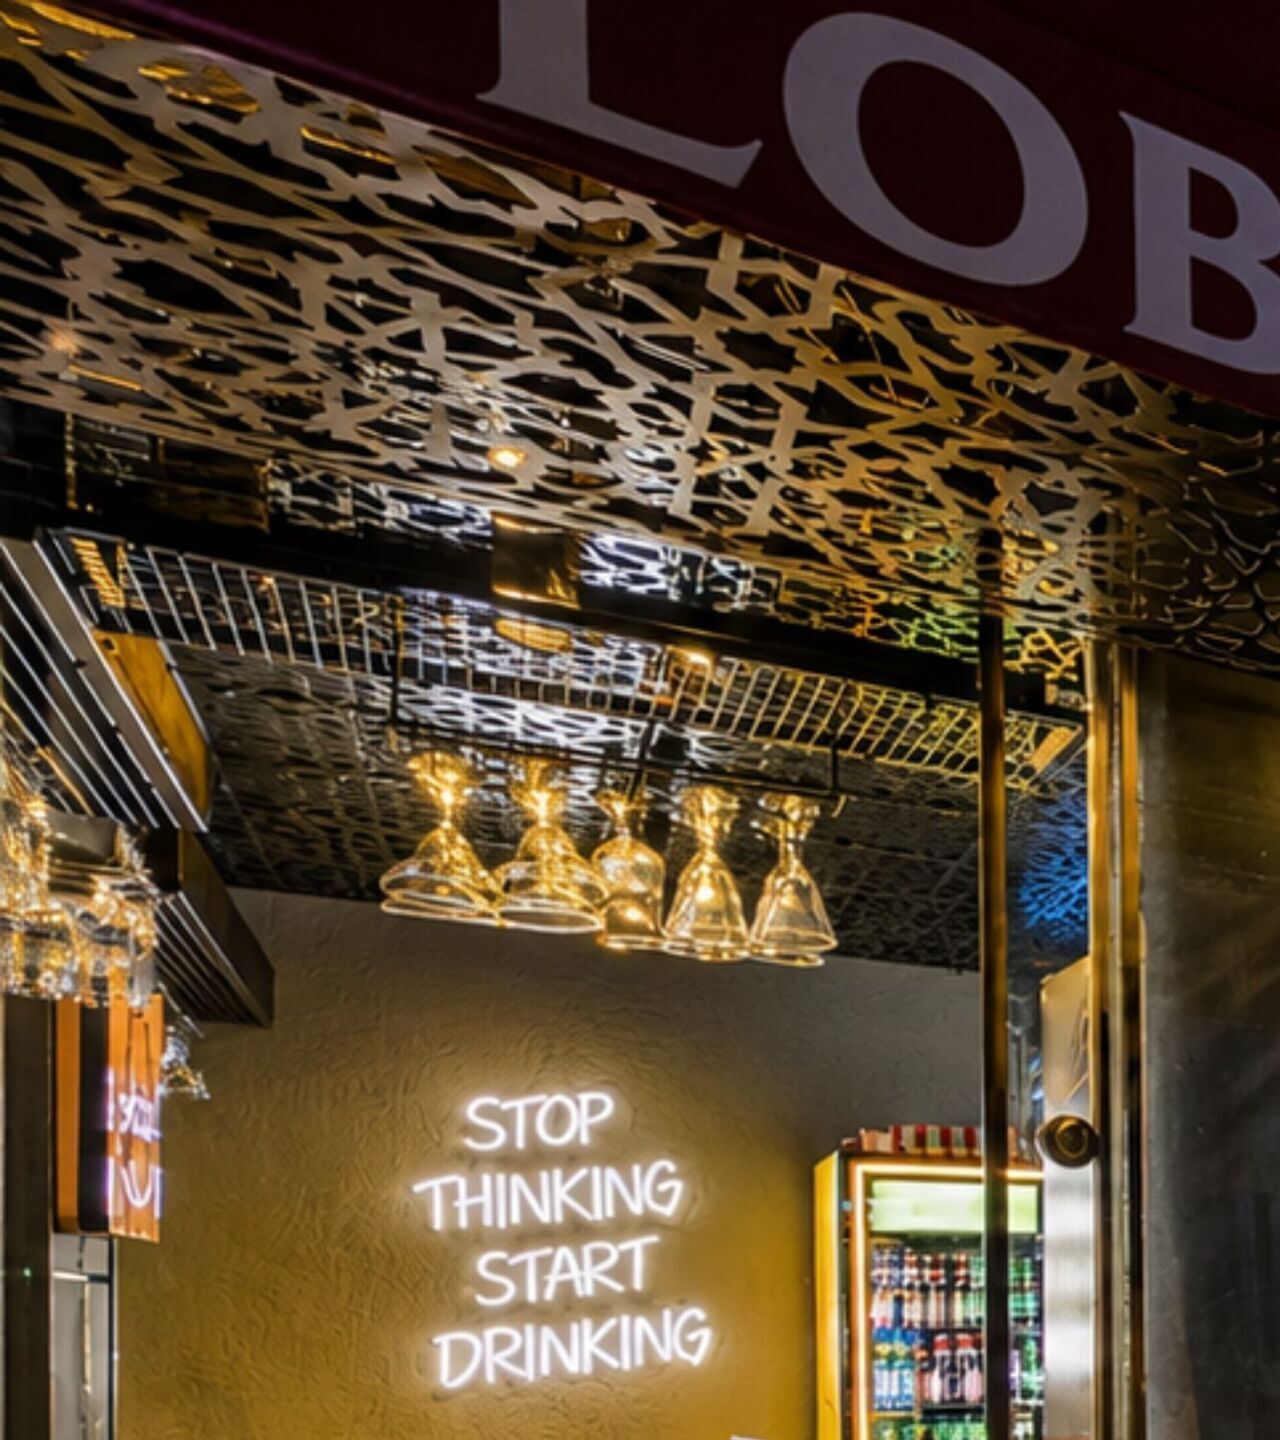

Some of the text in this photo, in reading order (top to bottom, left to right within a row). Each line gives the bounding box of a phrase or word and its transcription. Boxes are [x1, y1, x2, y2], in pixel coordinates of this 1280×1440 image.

[463, 1091, 615, 1152] STOP
[412, 1159, 685, 1231] THINKING
[474, 1234, 660, 1307] START
[432, 1306, 713, 1389] DRINKING
